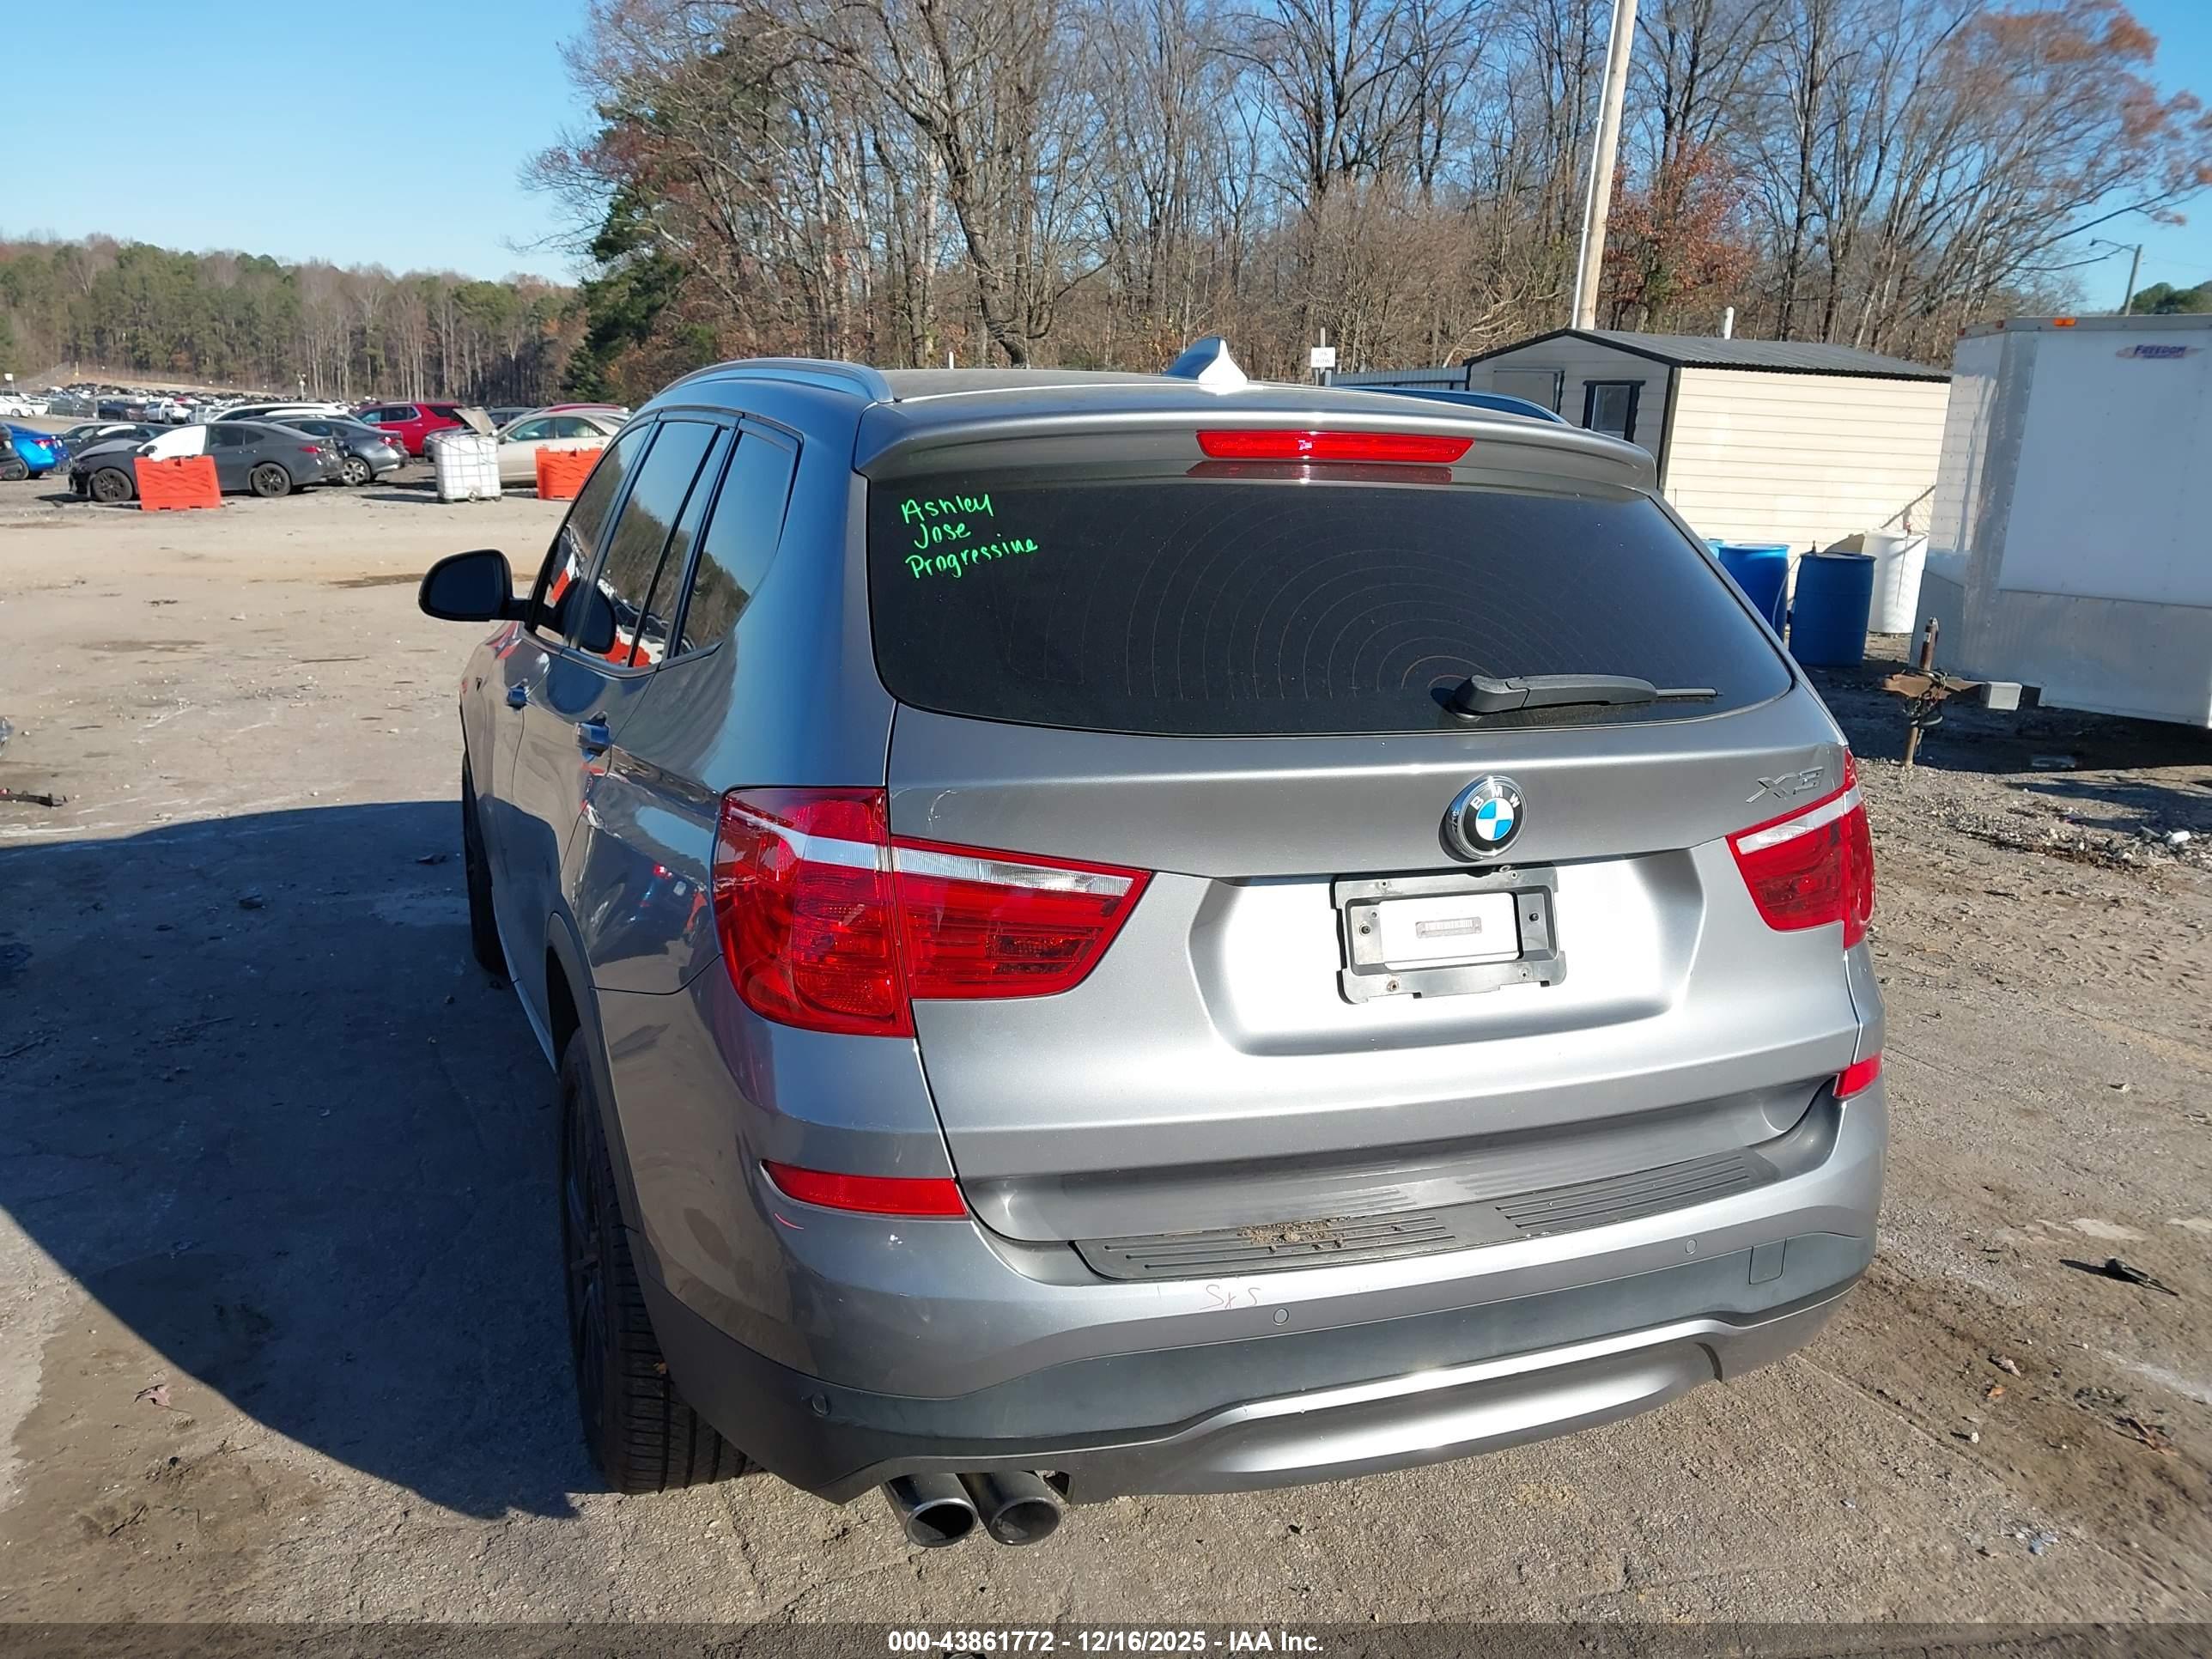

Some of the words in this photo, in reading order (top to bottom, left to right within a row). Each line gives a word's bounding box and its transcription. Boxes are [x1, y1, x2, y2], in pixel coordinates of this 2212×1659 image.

[901, 494, 994, 523] Ashley
[914, 522, 971, 550] Jose
[1470, 785, 1520, 811] BMW
